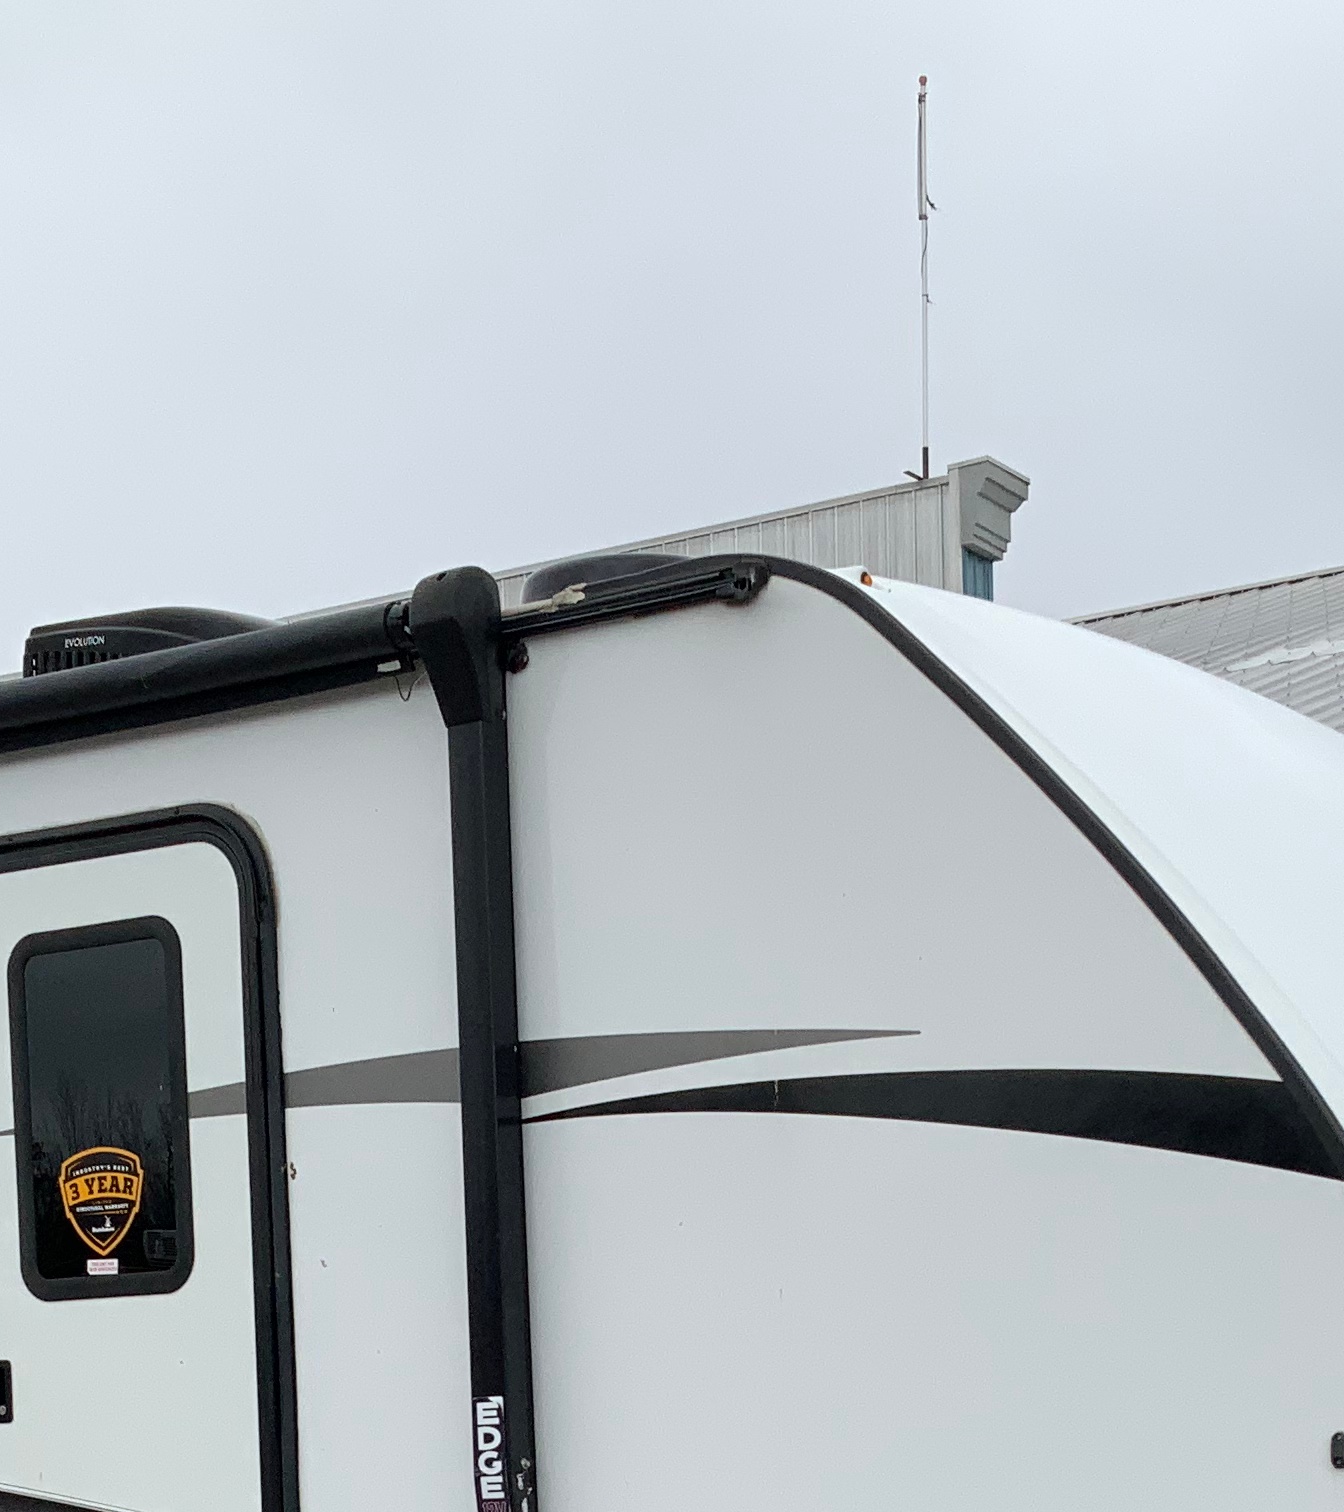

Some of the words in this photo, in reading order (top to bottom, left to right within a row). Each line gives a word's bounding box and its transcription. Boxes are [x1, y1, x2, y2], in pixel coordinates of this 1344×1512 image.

[64, 635, 105, 649] EVOLUTION
[69, 1183, 80, 1201] 3
[84, 1175, 134, 1196] YEAR
[476, 1401, 505, 1500] EDGE
